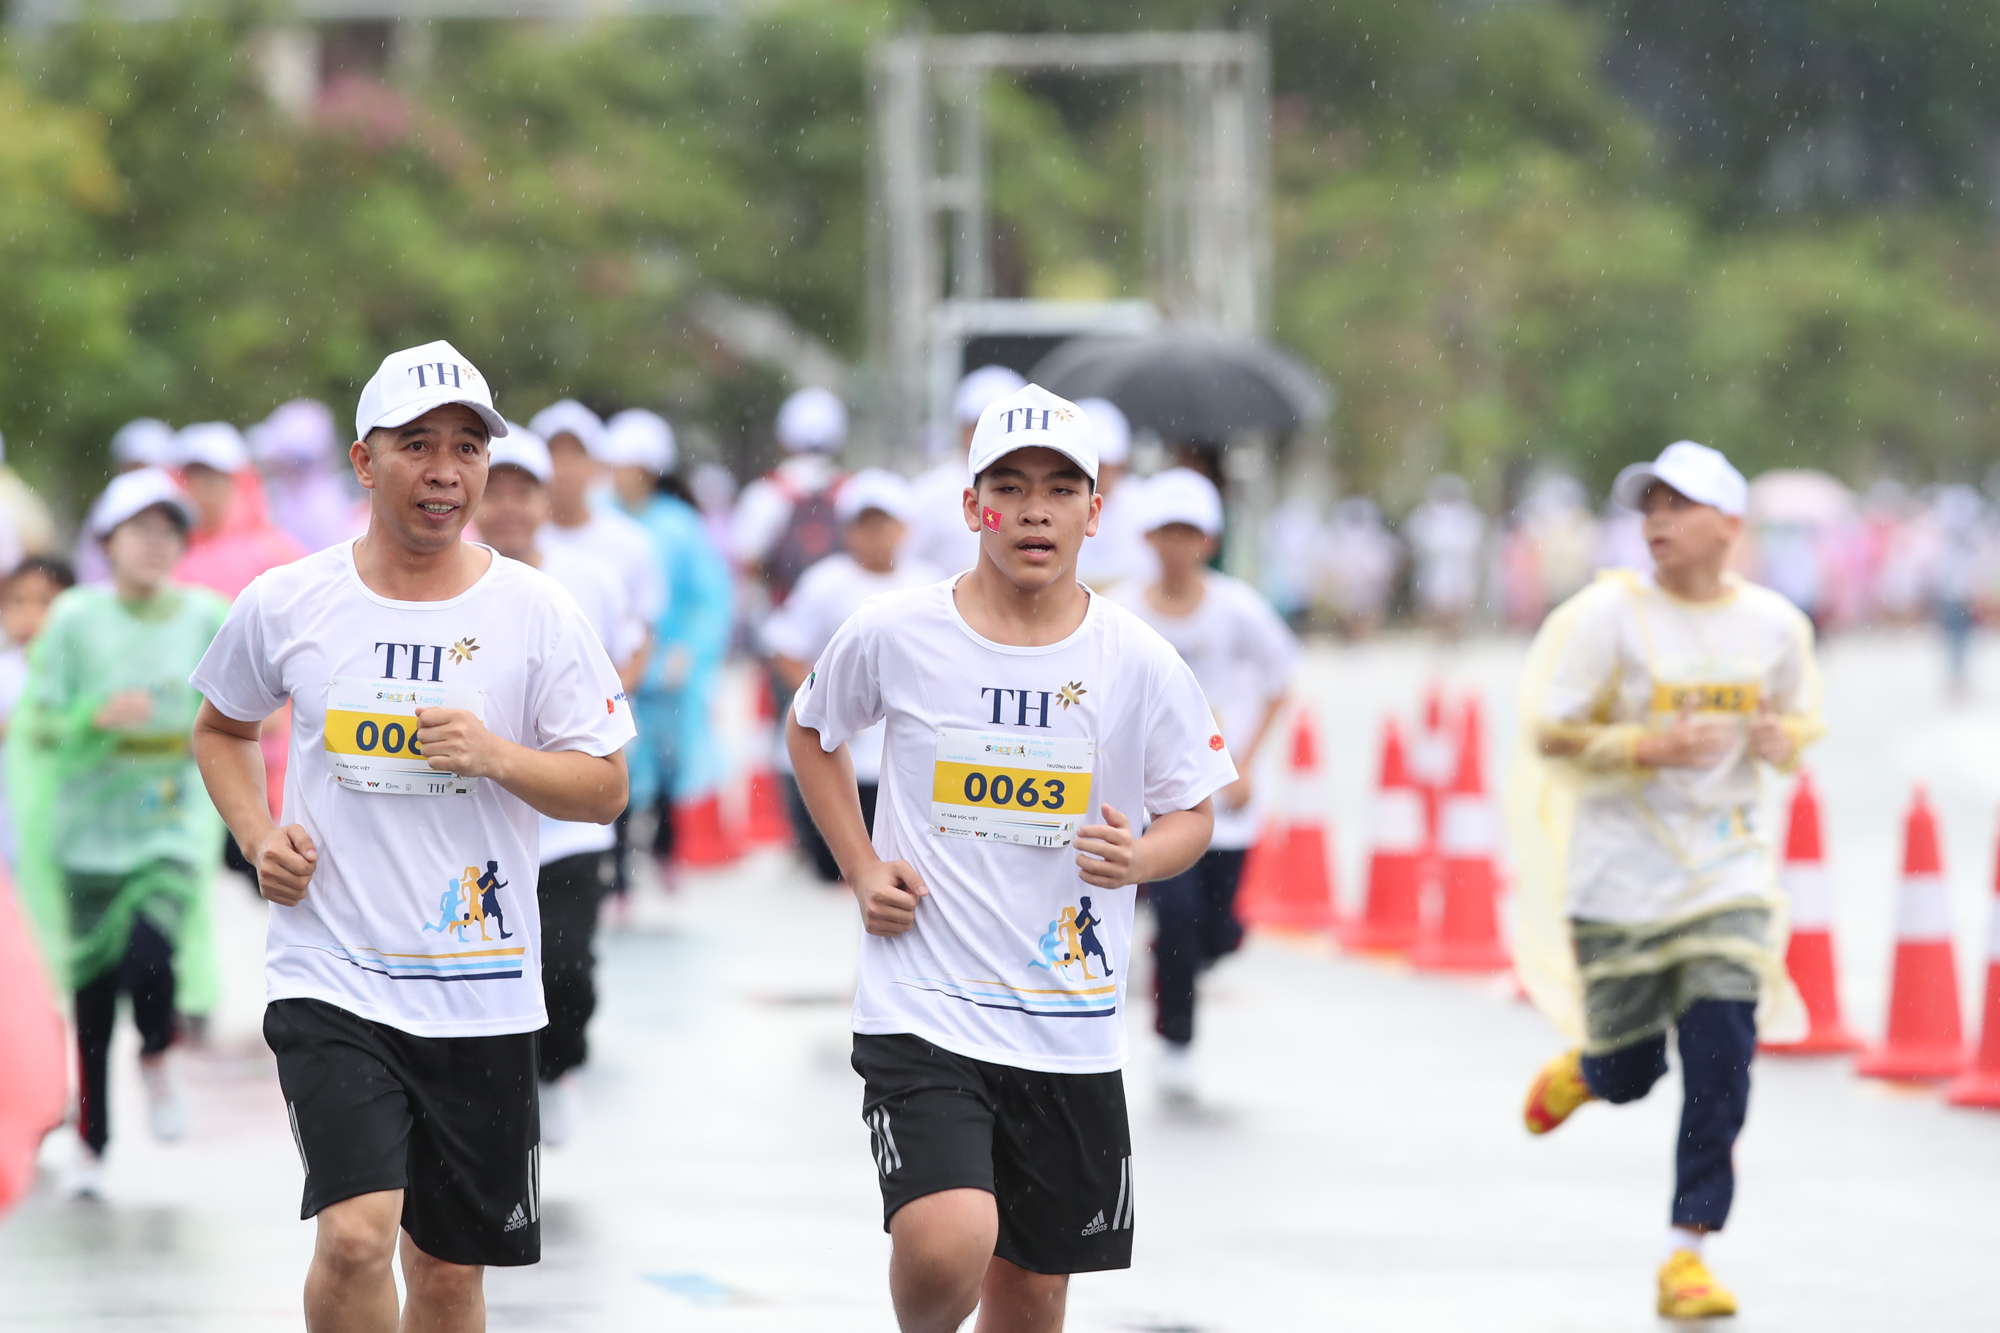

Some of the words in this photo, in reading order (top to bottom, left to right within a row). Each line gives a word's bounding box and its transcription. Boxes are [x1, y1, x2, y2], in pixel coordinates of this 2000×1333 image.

[408, 362, 463, 390] TH
[999, 407, 1052, 435] TH
[374, 642, 446, 683] TH
[420, 695, 444, 706] Family
[981, 687, 1053, 729] TH
[1028, 748, 1052, 758] Family
[428, 783, 445, 793] TH
[963, 772, 1066, 809] 0063
[1035, 835, 1053, 846] TH
[504, 1217, 528, 1232] adidas
[1081, 1222, 1108, 1236] adidas
